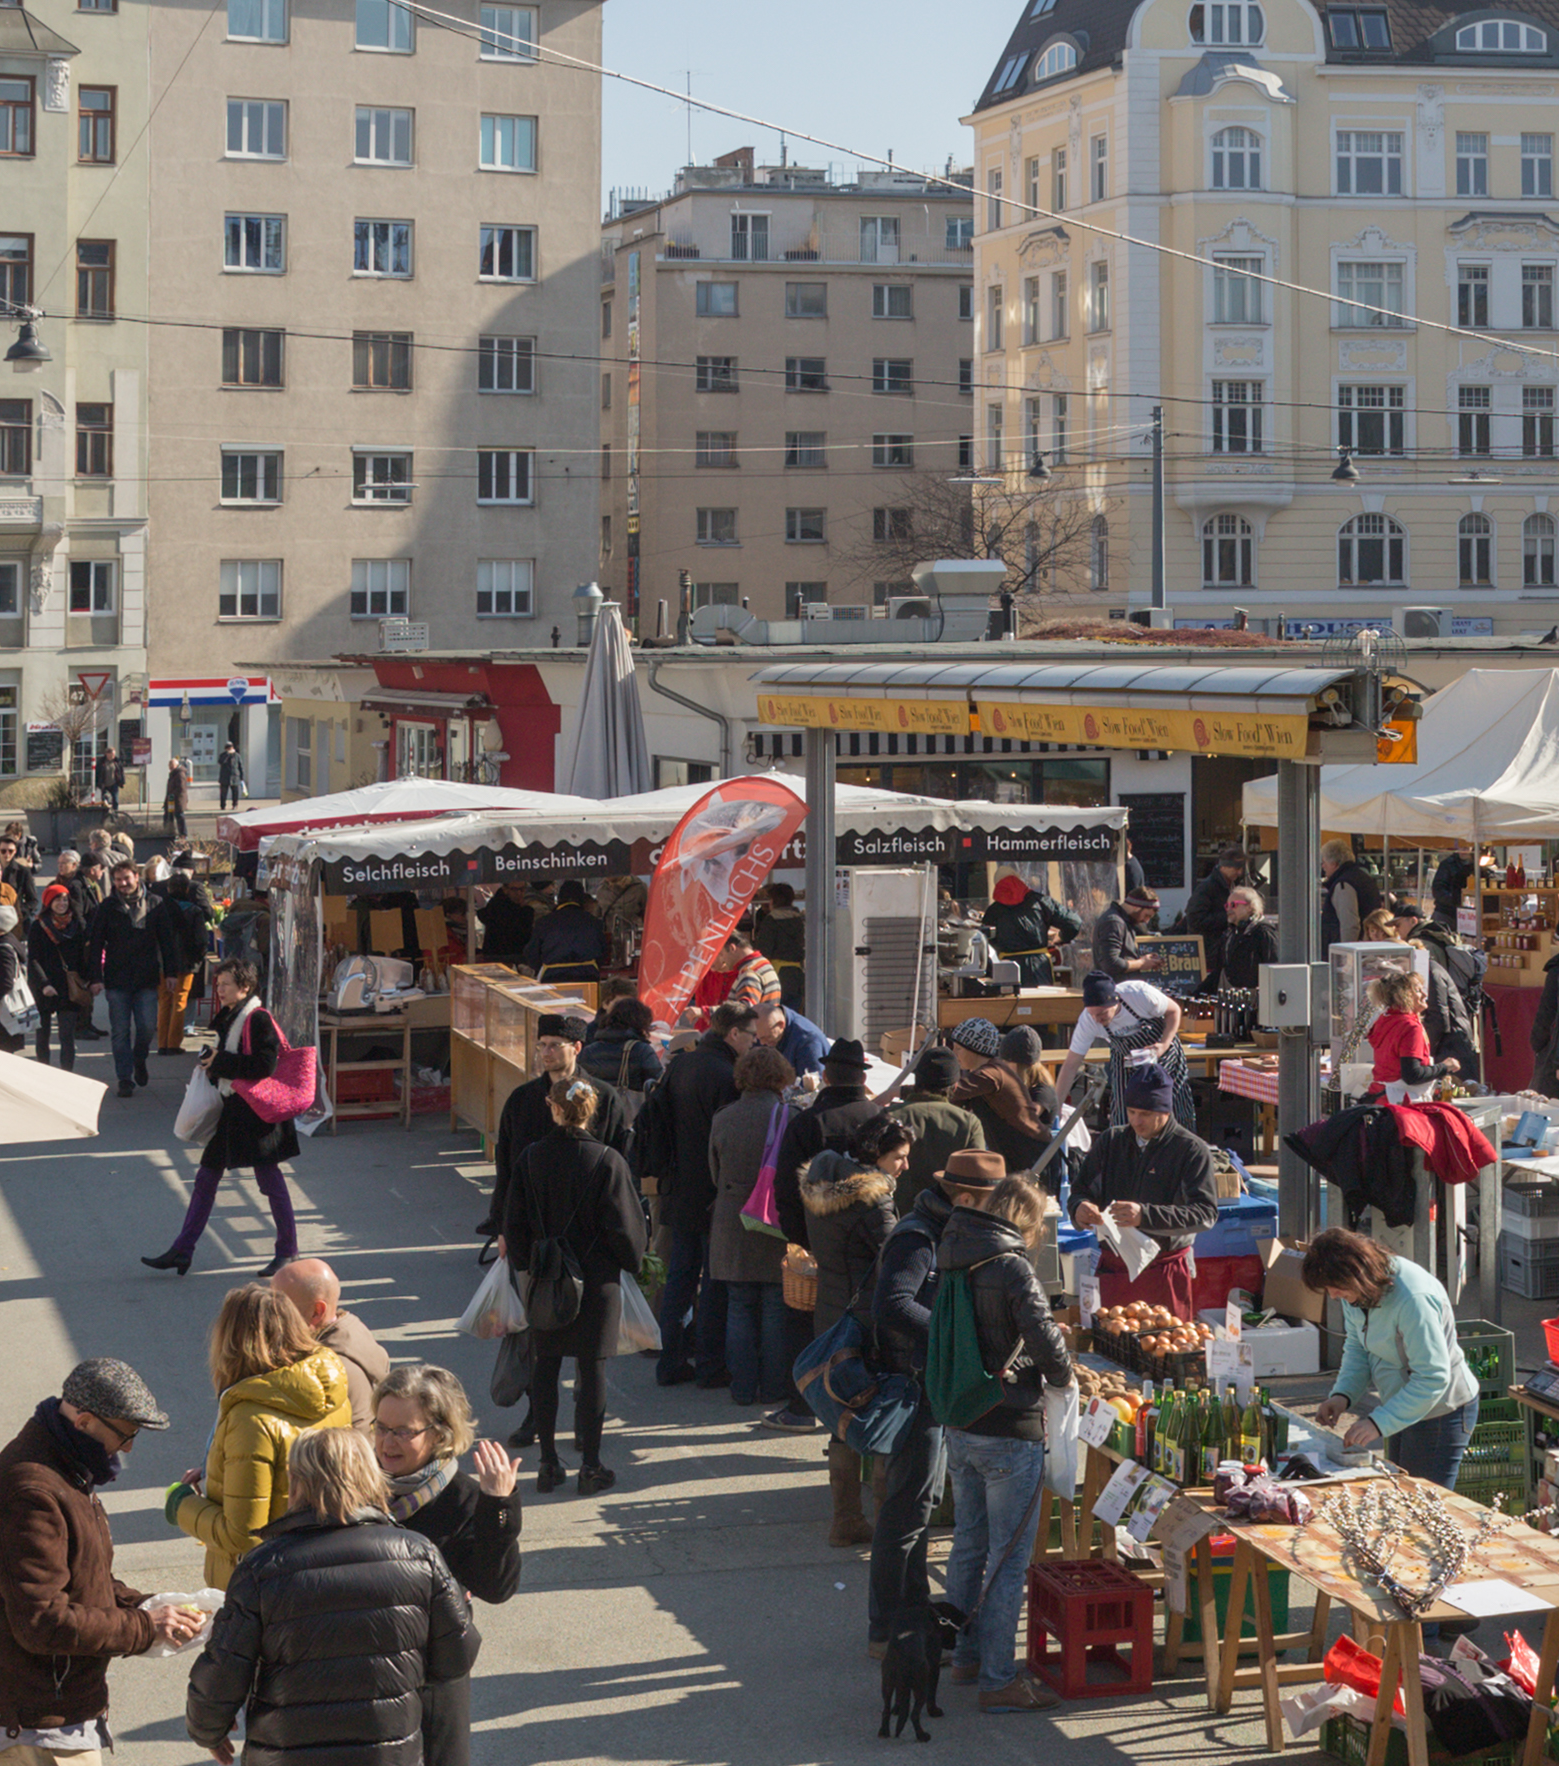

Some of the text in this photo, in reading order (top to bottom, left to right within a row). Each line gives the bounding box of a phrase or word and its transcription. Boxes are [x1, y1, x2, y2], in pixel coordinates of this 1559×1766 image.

[71, 690, 85, 701] 47
[1103, 715, 1121, 734] Slow
[1147, 718, 1169, 737] Wien
[1213, 720, 1235, 743] Slow
[1264, 722, 1293, 745] Wien
[342, 833, 1111, 884] Selchfleisch Beinschinken Salzfleisch Hammerfleisch
[1168, 953, 1201, 972] Bräu
